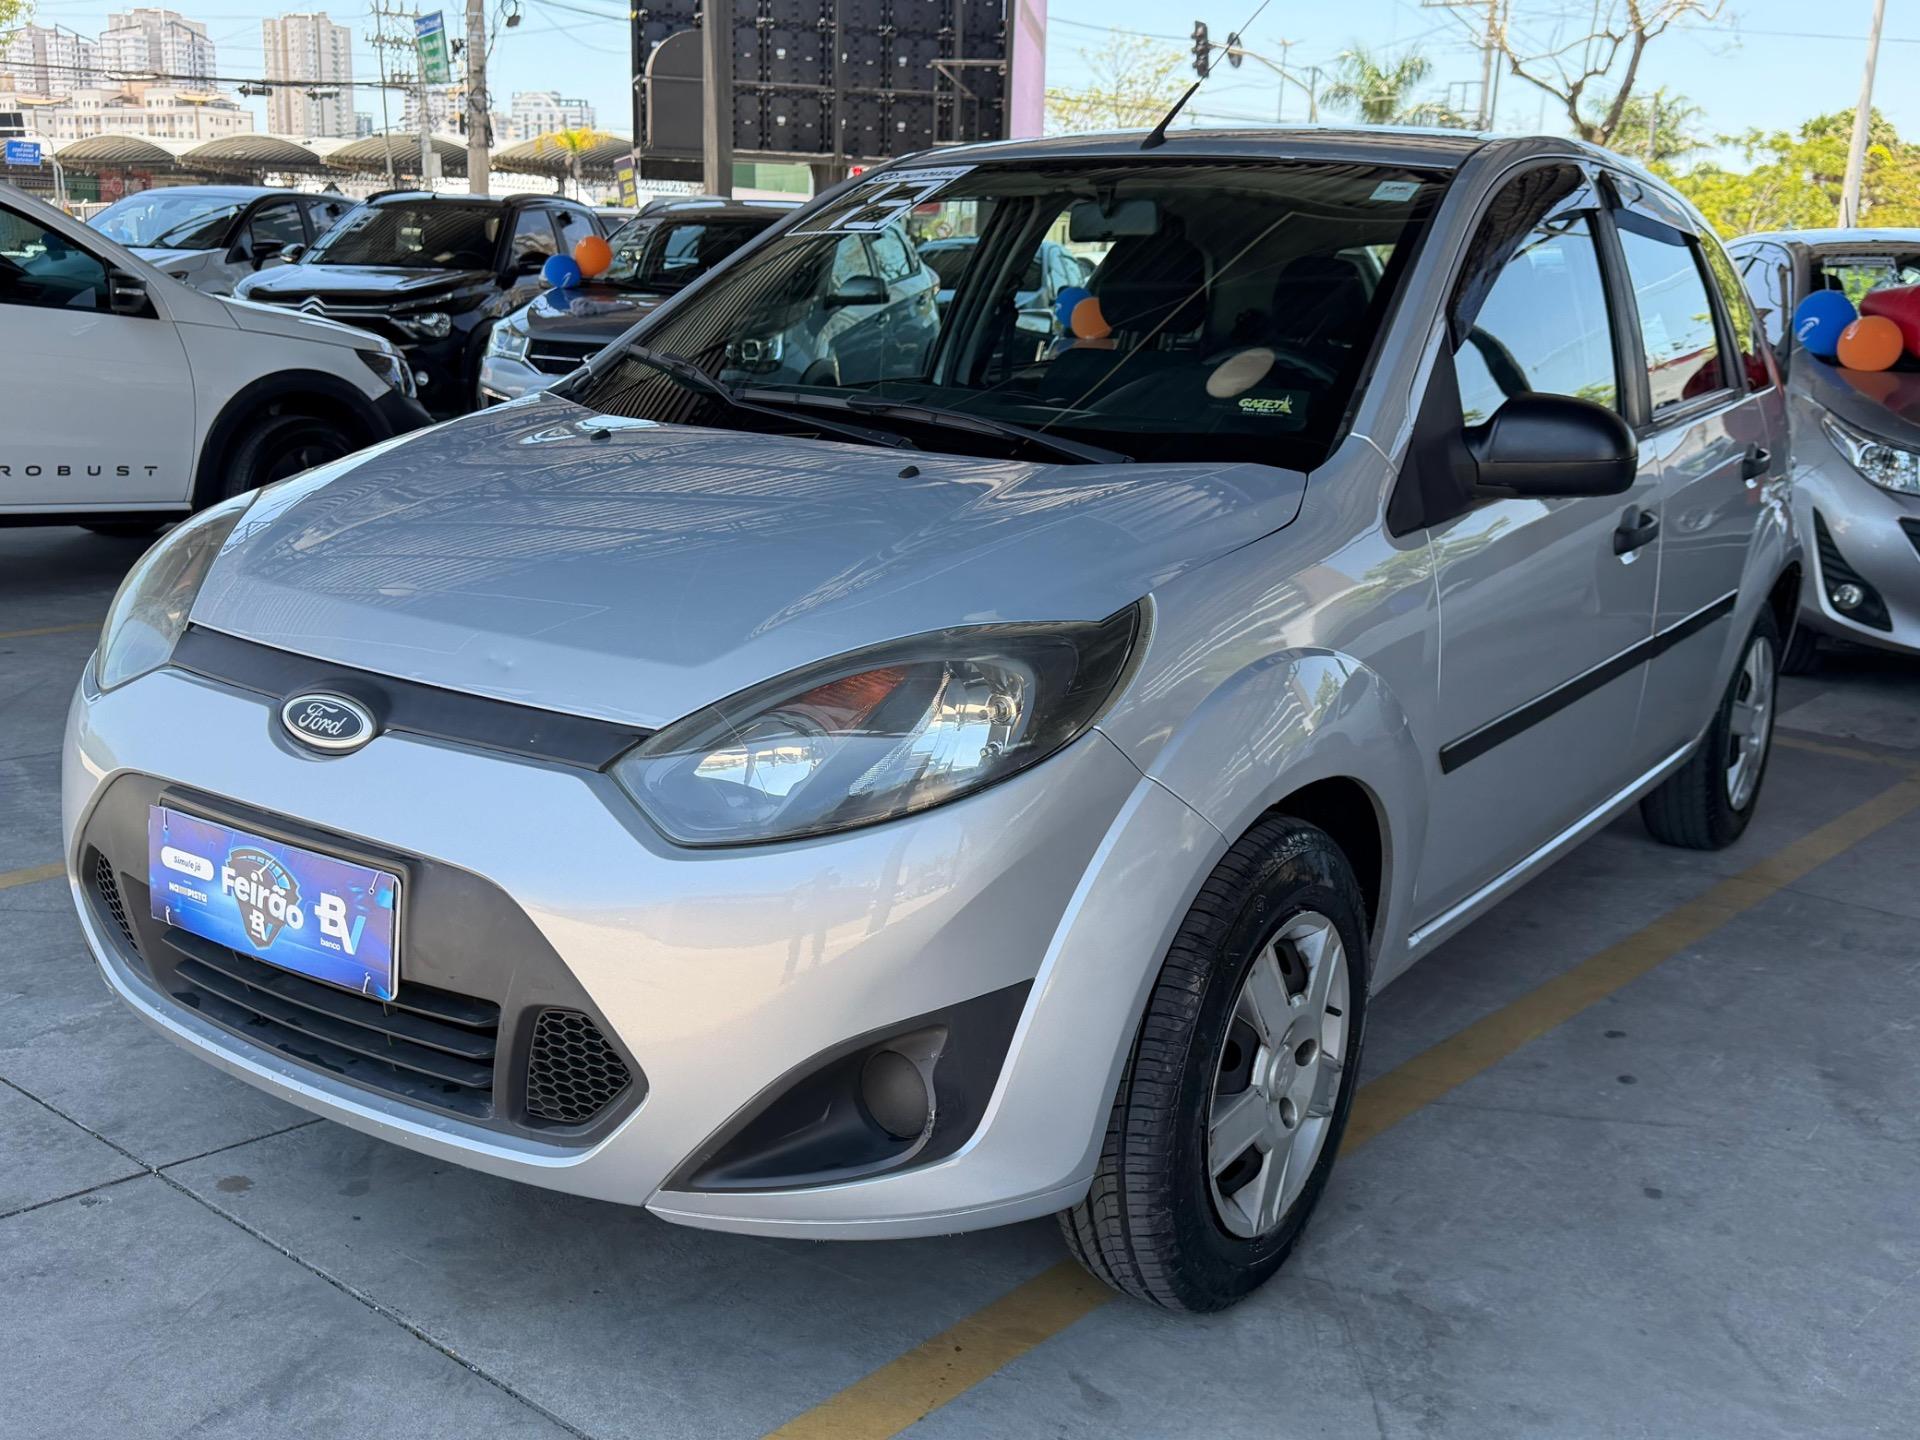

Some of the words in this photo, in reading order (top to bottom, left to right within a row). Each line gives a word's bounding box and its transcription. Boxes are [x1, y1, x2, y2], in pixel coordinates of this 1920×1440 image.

[0, 465, 158, 477] ROBUST
[298, 702, 348, 735] Ford
[221, 865, 304, 930] Feirão
[314, 892, 366, 955] BV
[320, 937, 341, 951] banco
